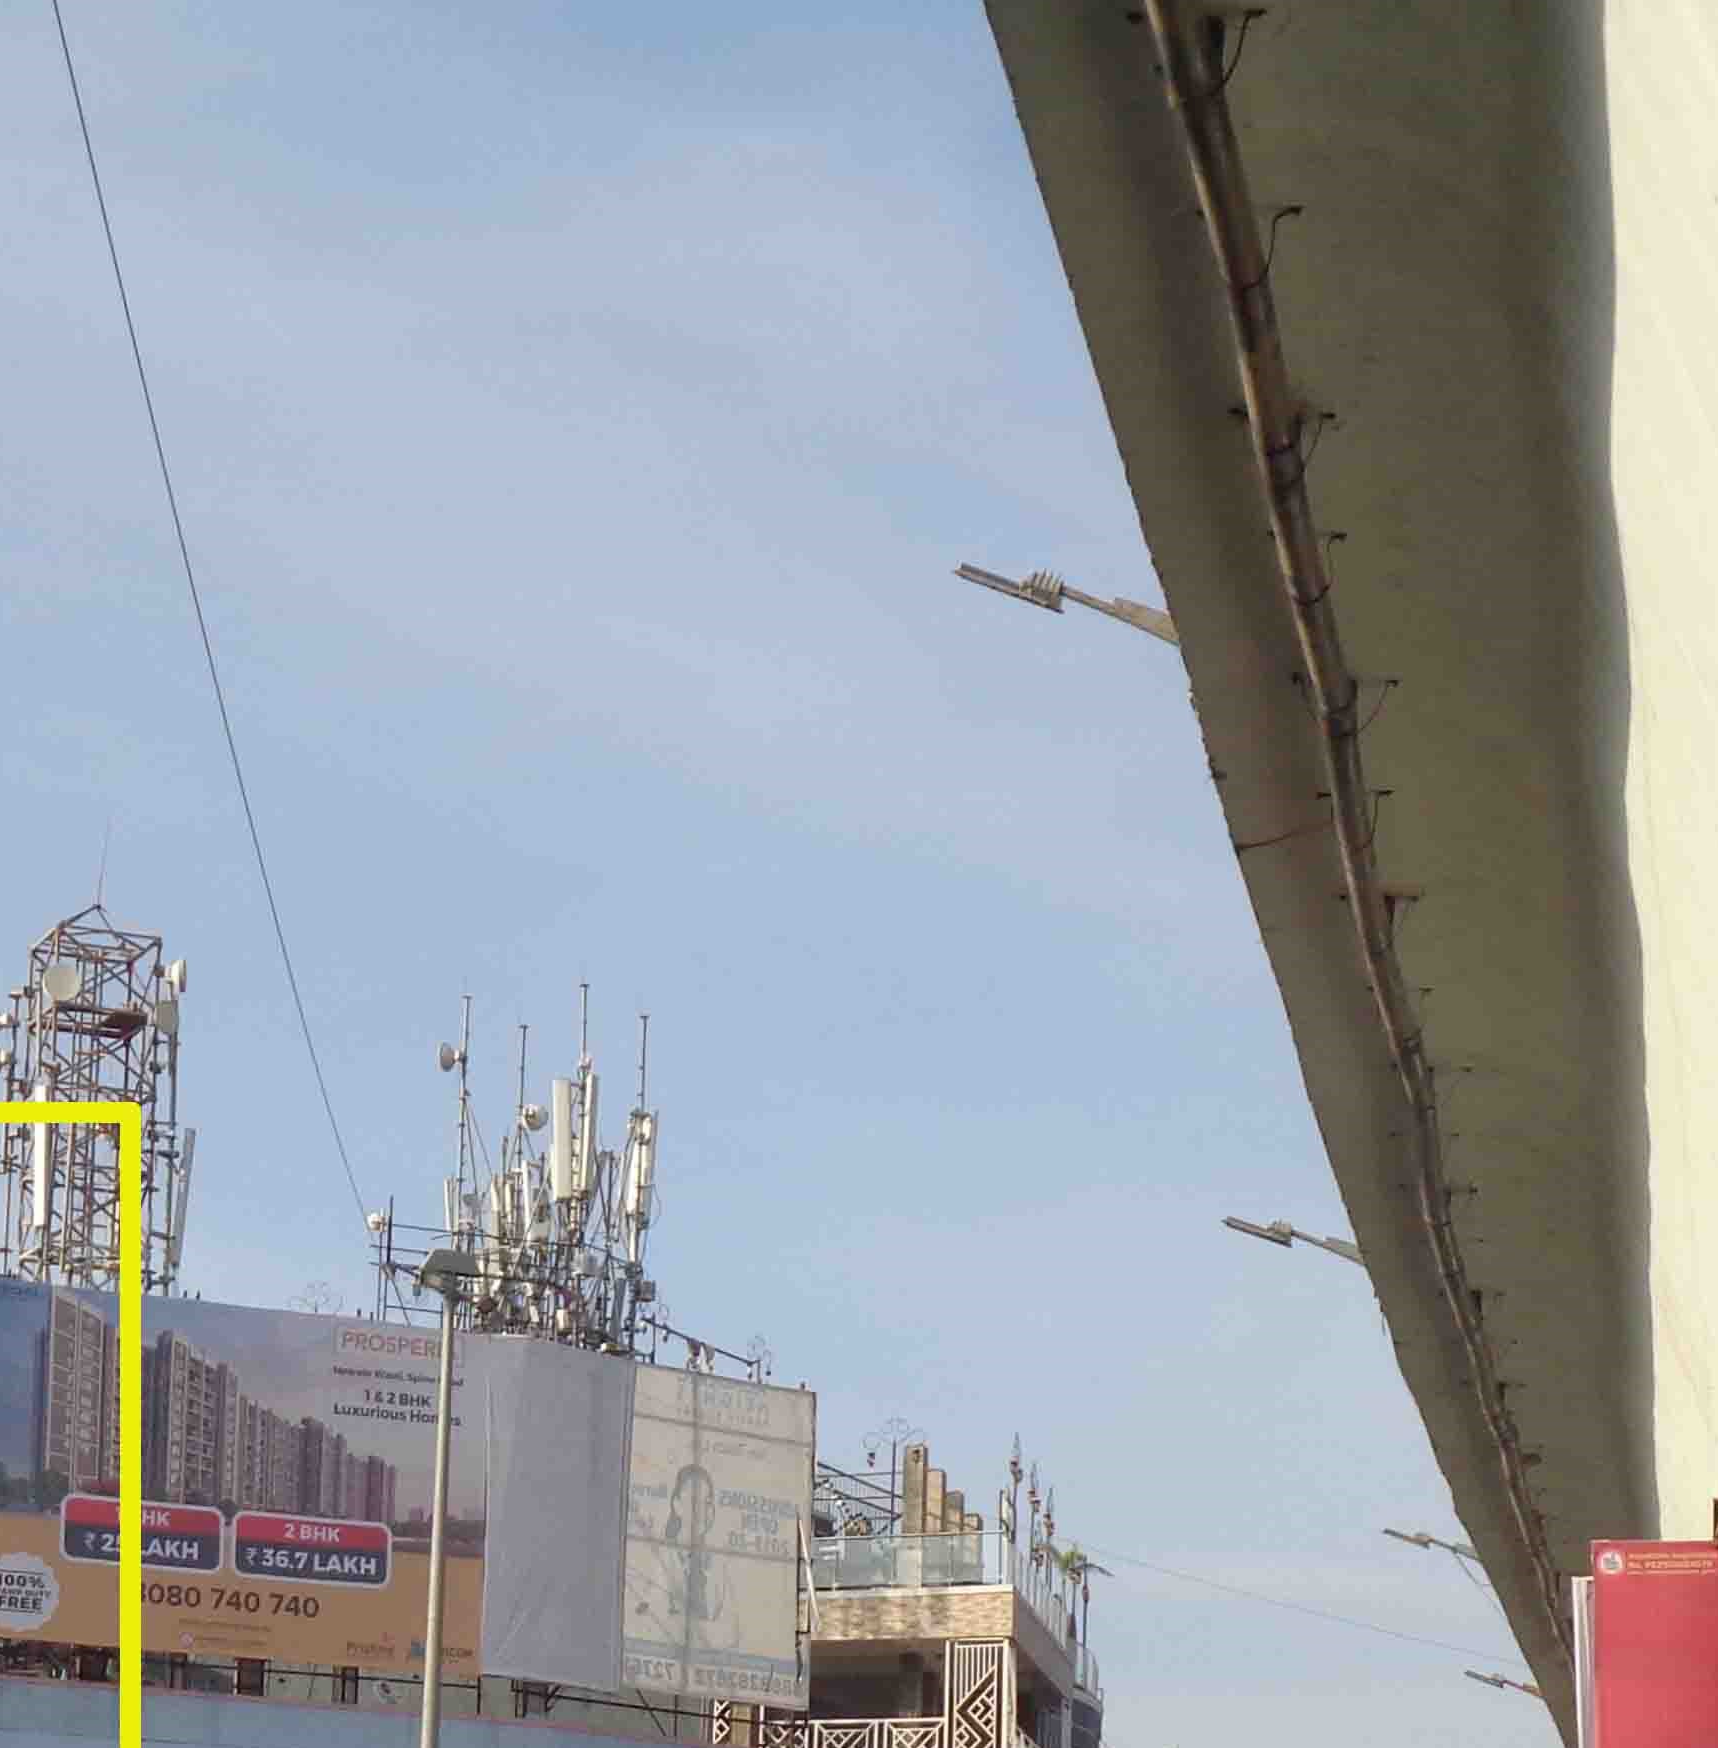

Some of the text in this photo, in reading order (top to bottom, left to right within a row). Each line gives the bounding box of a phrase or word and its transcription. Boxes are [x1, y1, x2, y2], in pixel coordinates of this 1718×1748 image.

[386, 1391, 396, 1404] 2
[398, 1393, 432, 1407] BHK
[333, 1403, 407, 1421] Luxurious
[284, 1523, 341, 1543] 2 BHK
[260, 1546, 309, 1569] 36.7
[312, 1554, 379, 1577] LAKH
[210, 1586, 261, 1614] 740
[269, 1593, 320, 1619] 740
